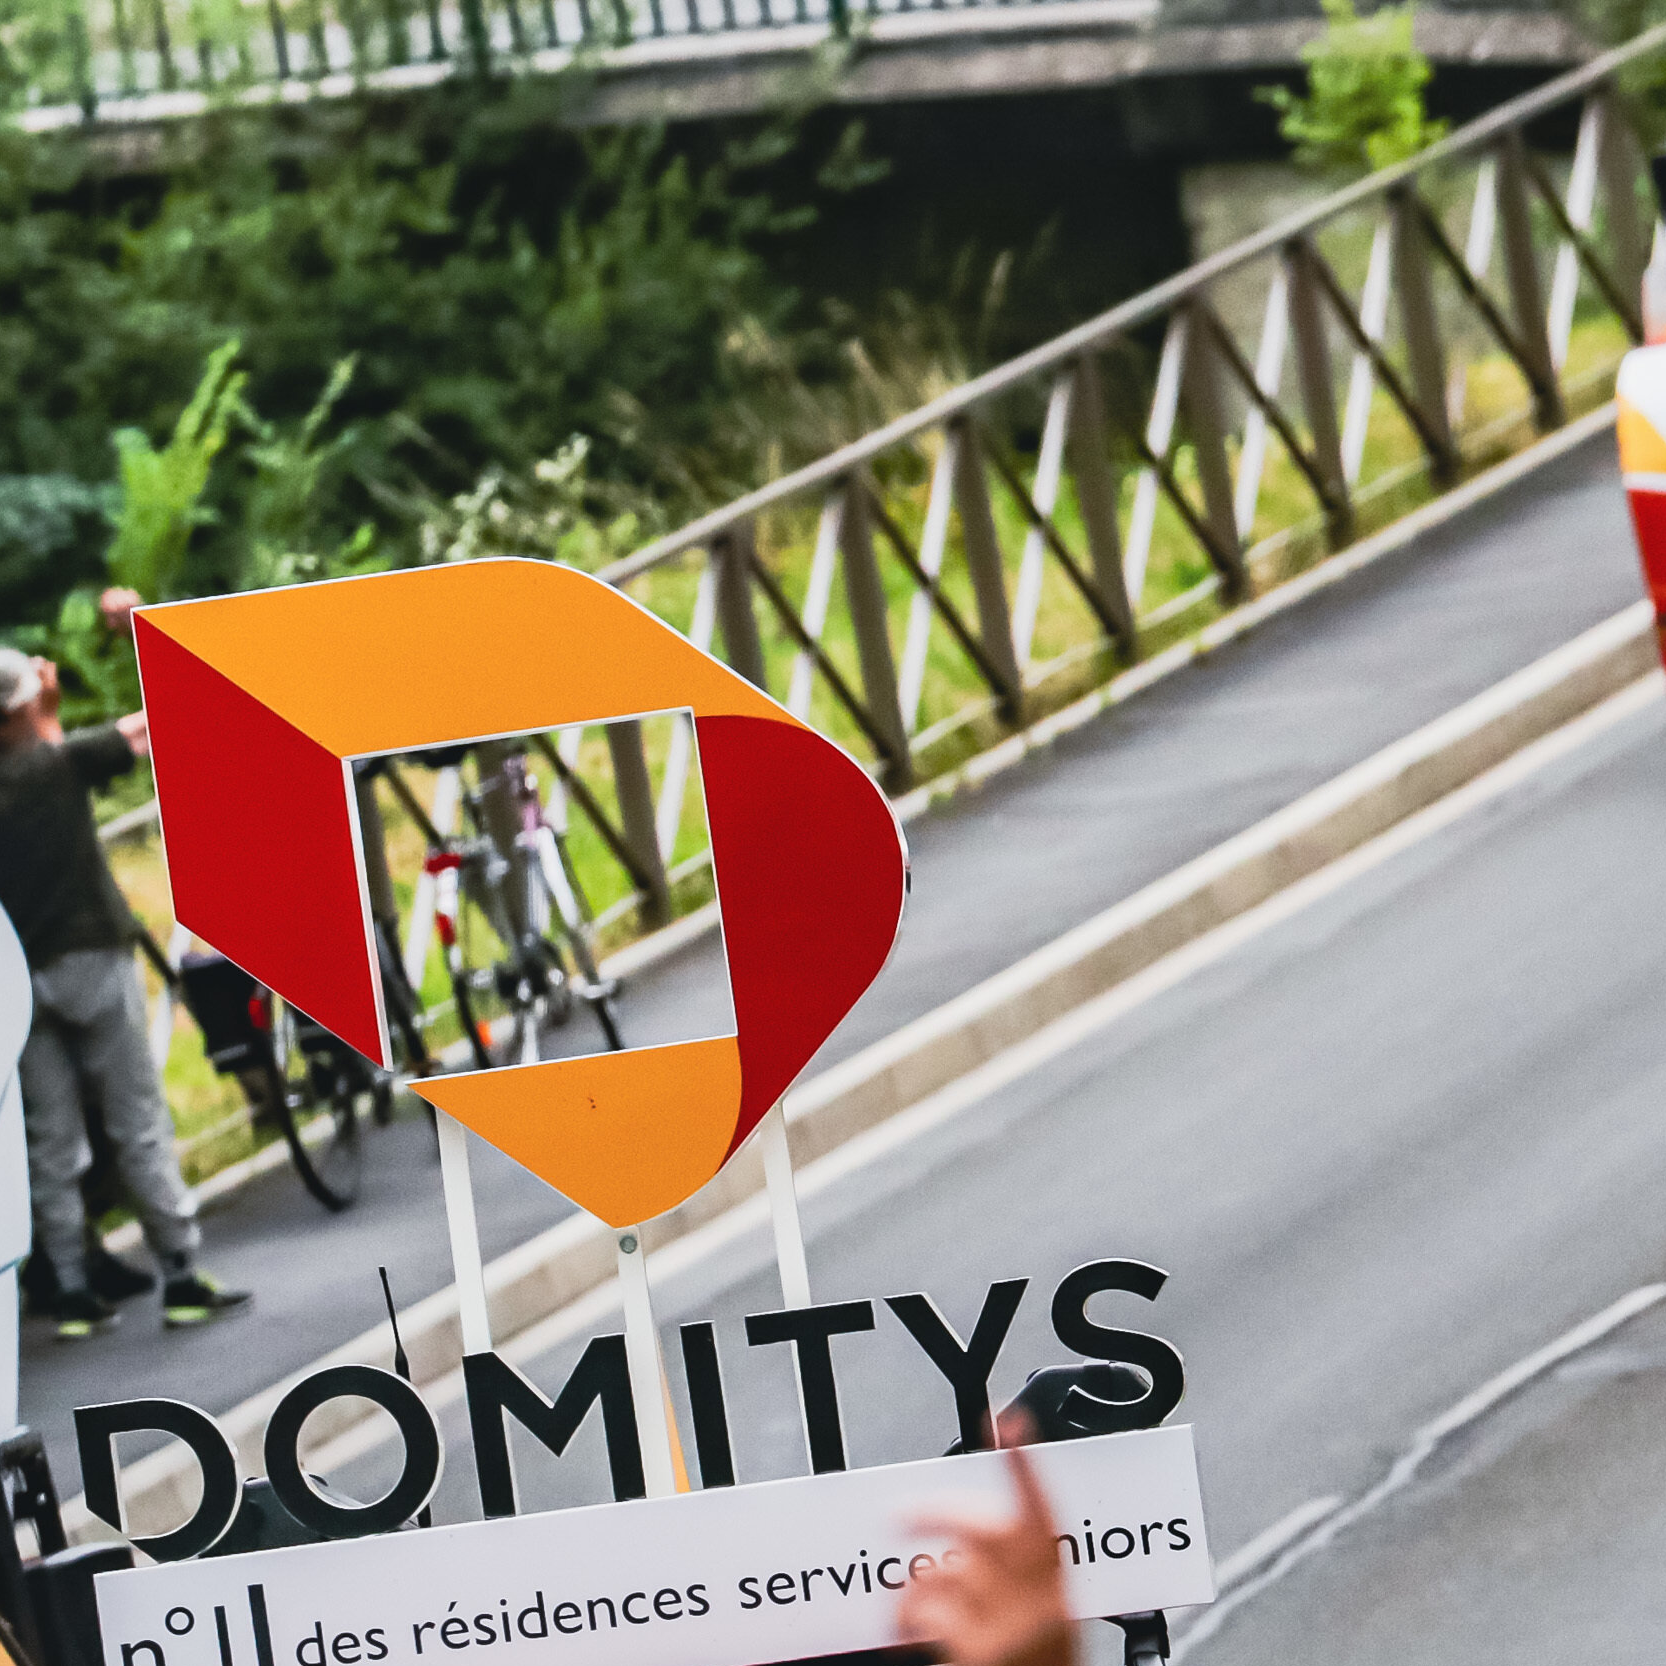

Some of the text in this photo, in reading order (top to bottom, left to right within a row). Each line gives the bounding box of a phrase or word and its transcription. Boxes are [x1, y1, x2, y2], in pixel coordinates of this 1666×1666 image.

[74, 1258, 1187, 1563] DOMITYS
[414, 1590, 711, 1655] résidences
[1056, 1517, 1192, 1566] niors
